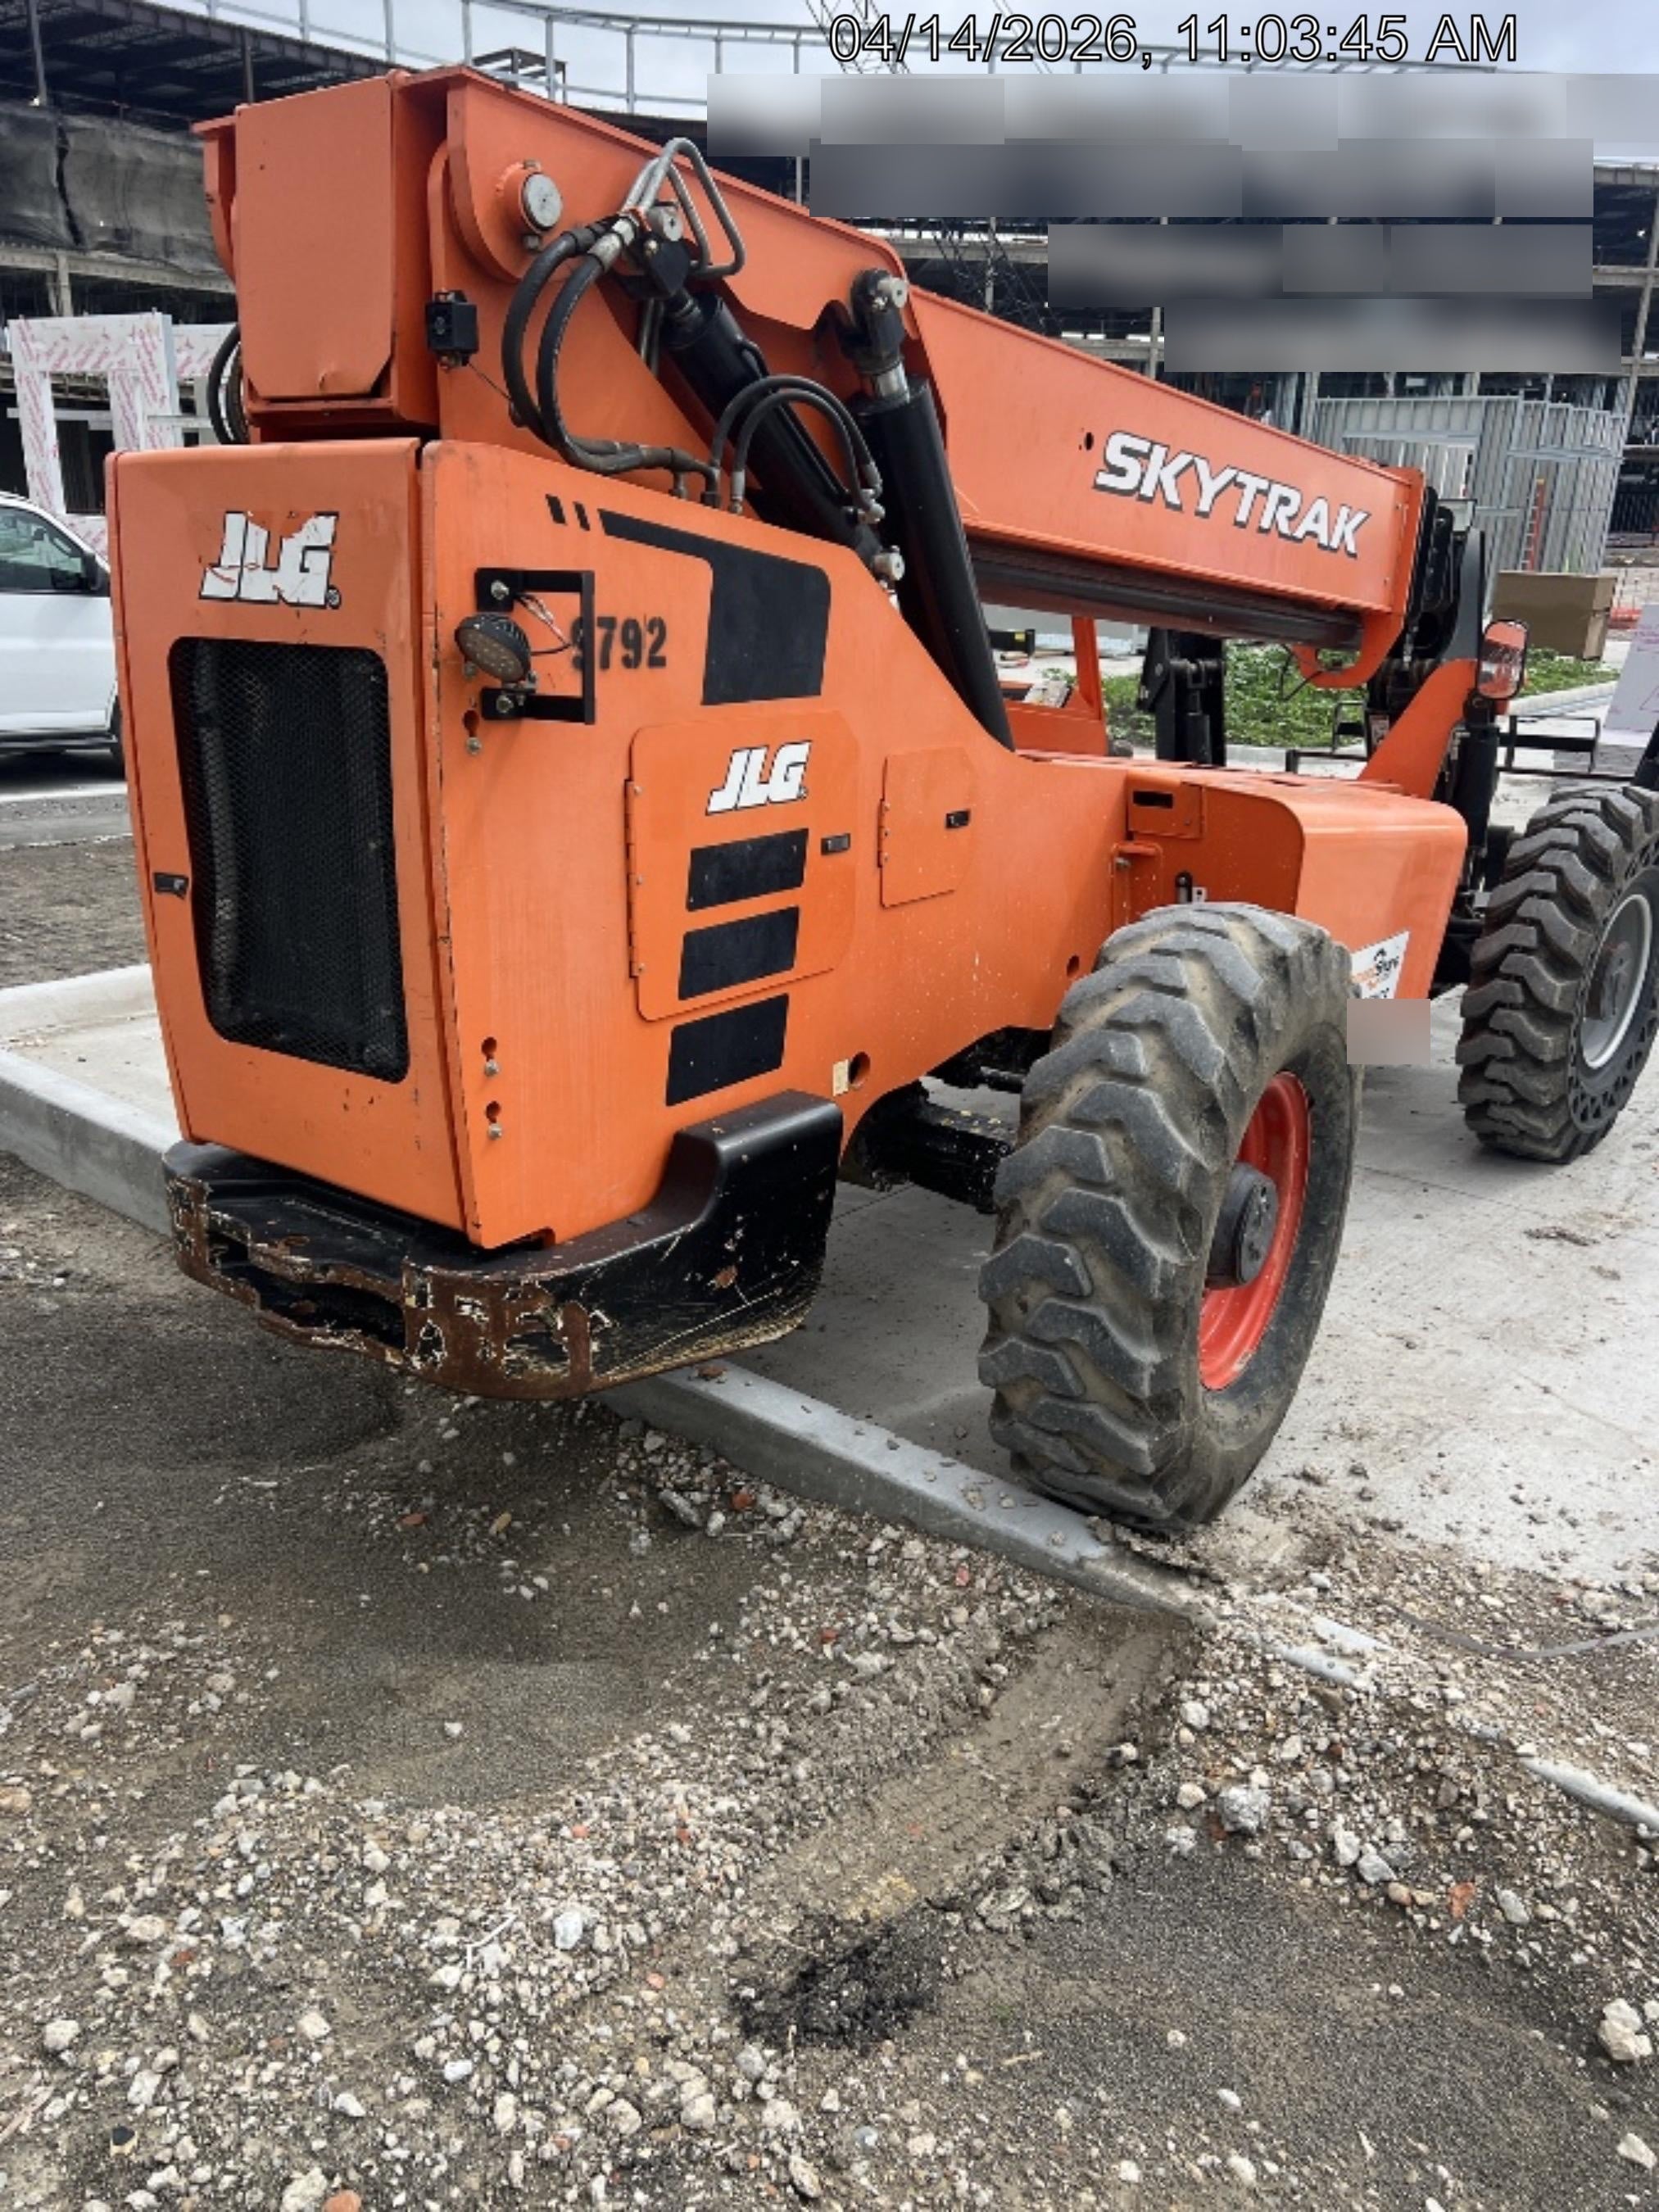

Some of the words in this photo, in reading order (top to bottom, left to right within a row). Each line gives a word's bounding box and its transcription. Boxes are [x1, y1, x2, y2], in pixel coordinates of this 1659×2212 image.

[1093, 429, 1371, 559] SKYTRAK
[199, 510, 340, 609] JLG
[705, 739, 812, 816] JLG
